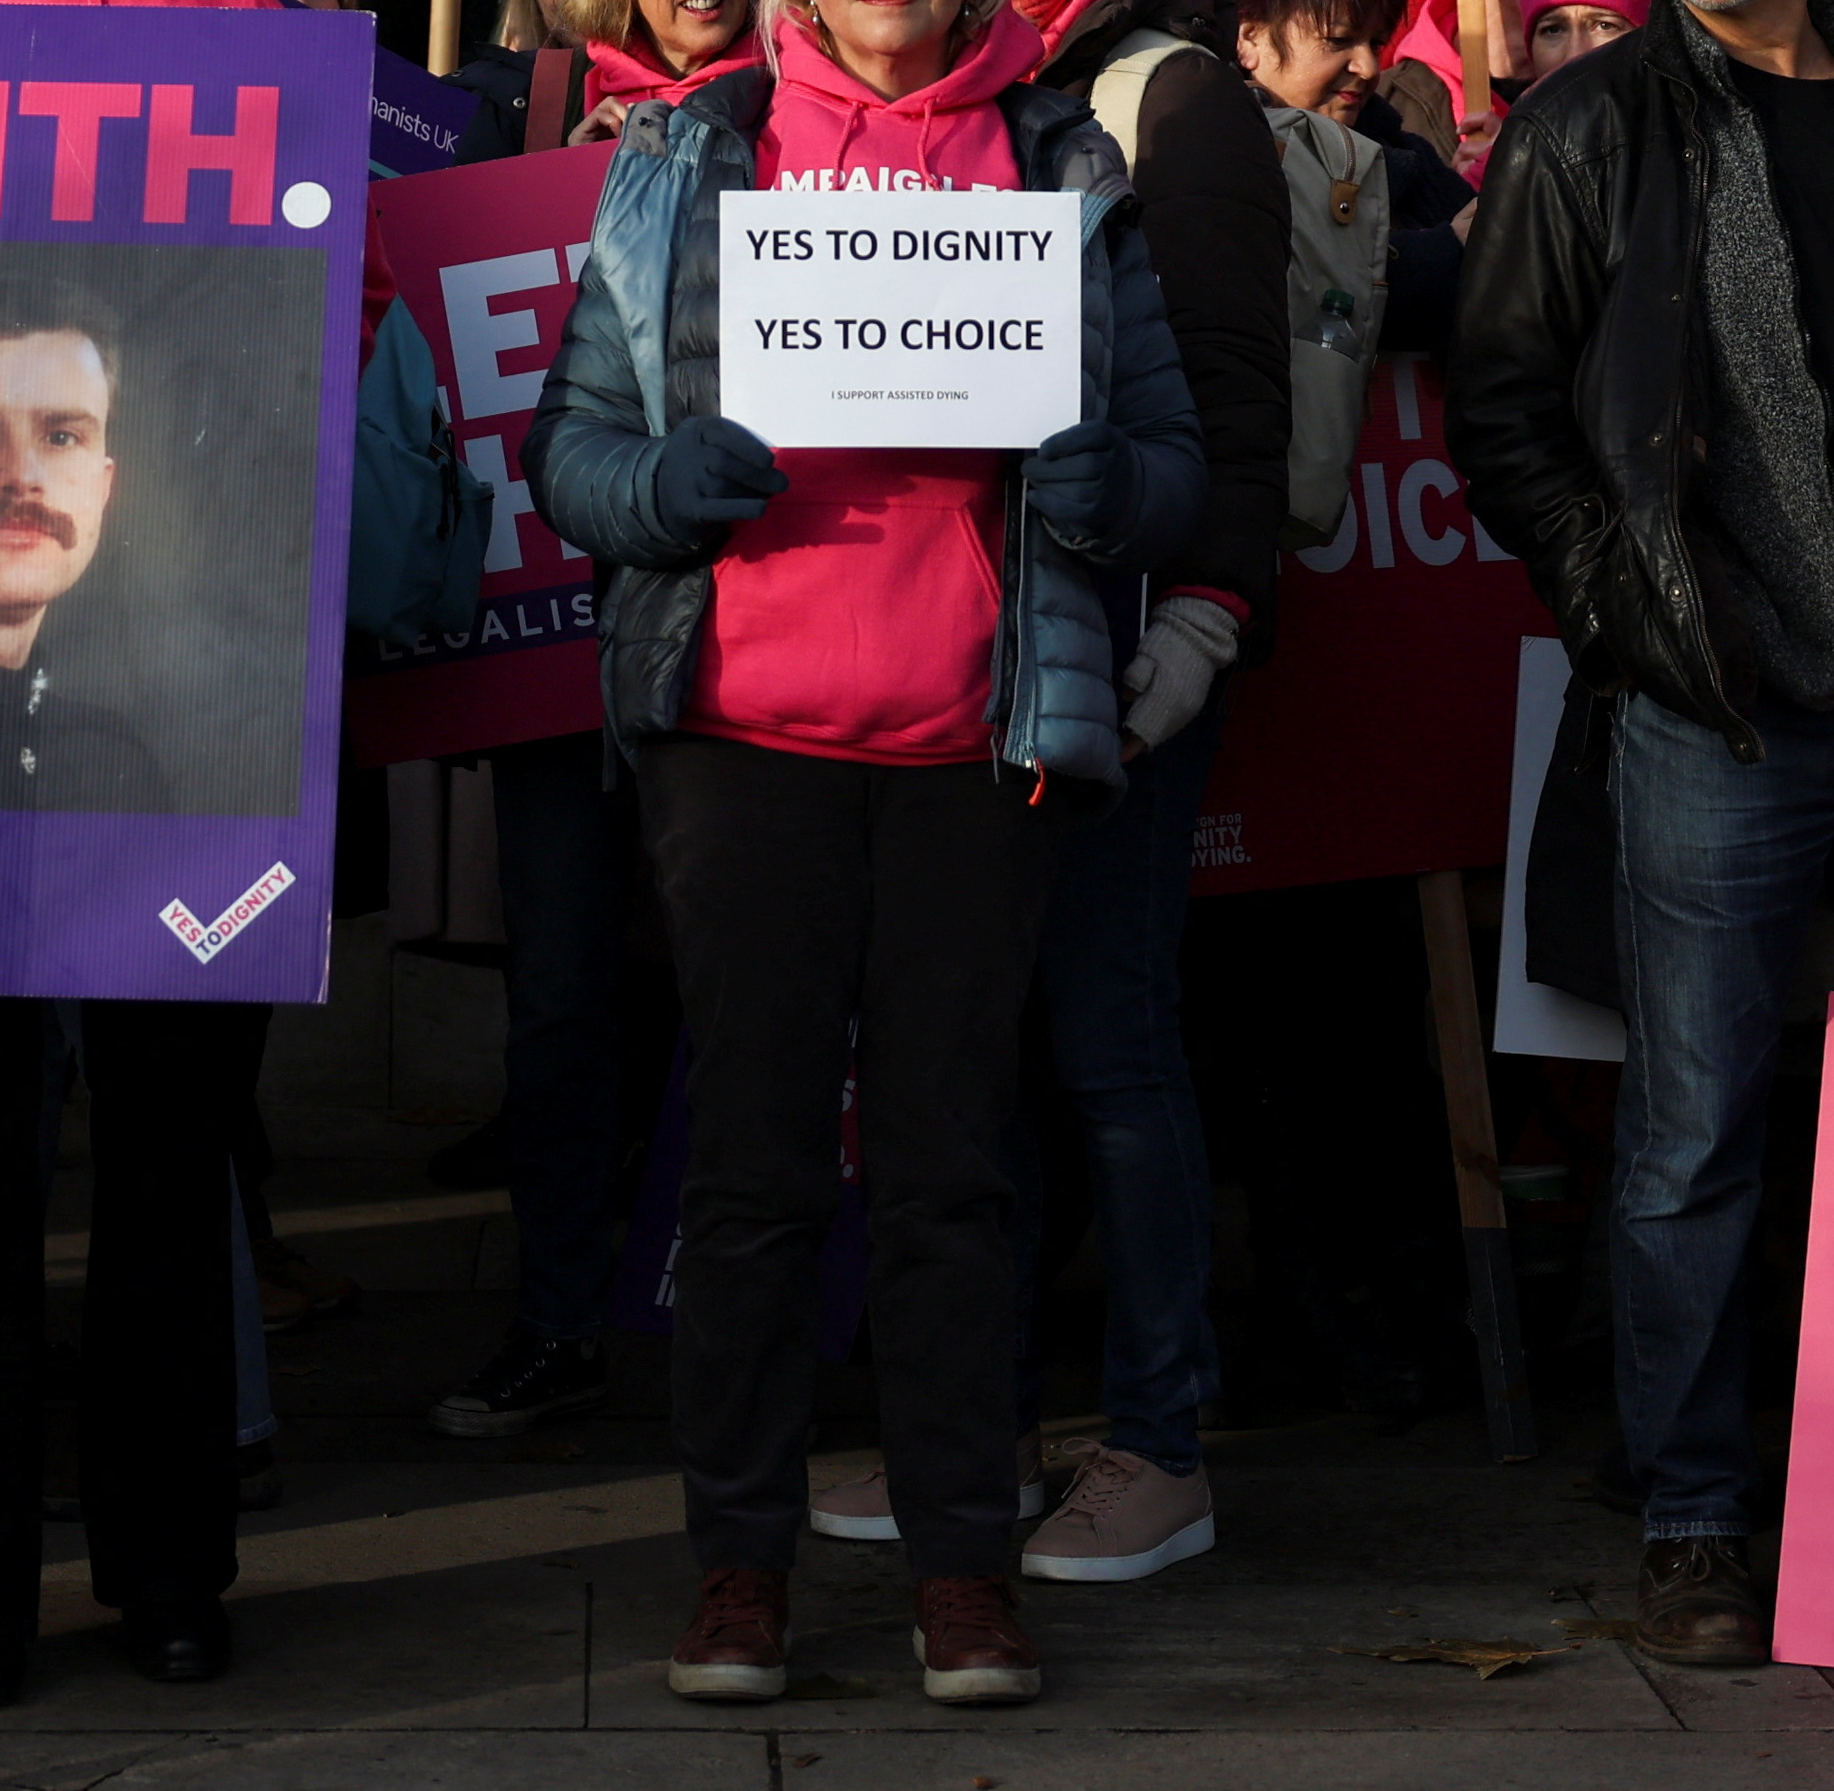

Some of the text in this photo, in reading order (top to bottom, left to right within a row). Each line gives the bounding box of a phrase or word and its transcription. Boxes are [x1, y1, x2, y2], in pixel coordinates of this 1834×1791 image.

[372, 96, 458, 154] anists UK
[747, 230, 1053, 261] YES TO DIGNITY
[756, 319, 1044, 350] YES TO CHOICE
[837, 390, 884, 400] SUPPORT
[887, 390, 934, 400] ASSISTED
[937, 390, 969, 400] DYING
[169, 905, 202, 943] YES
